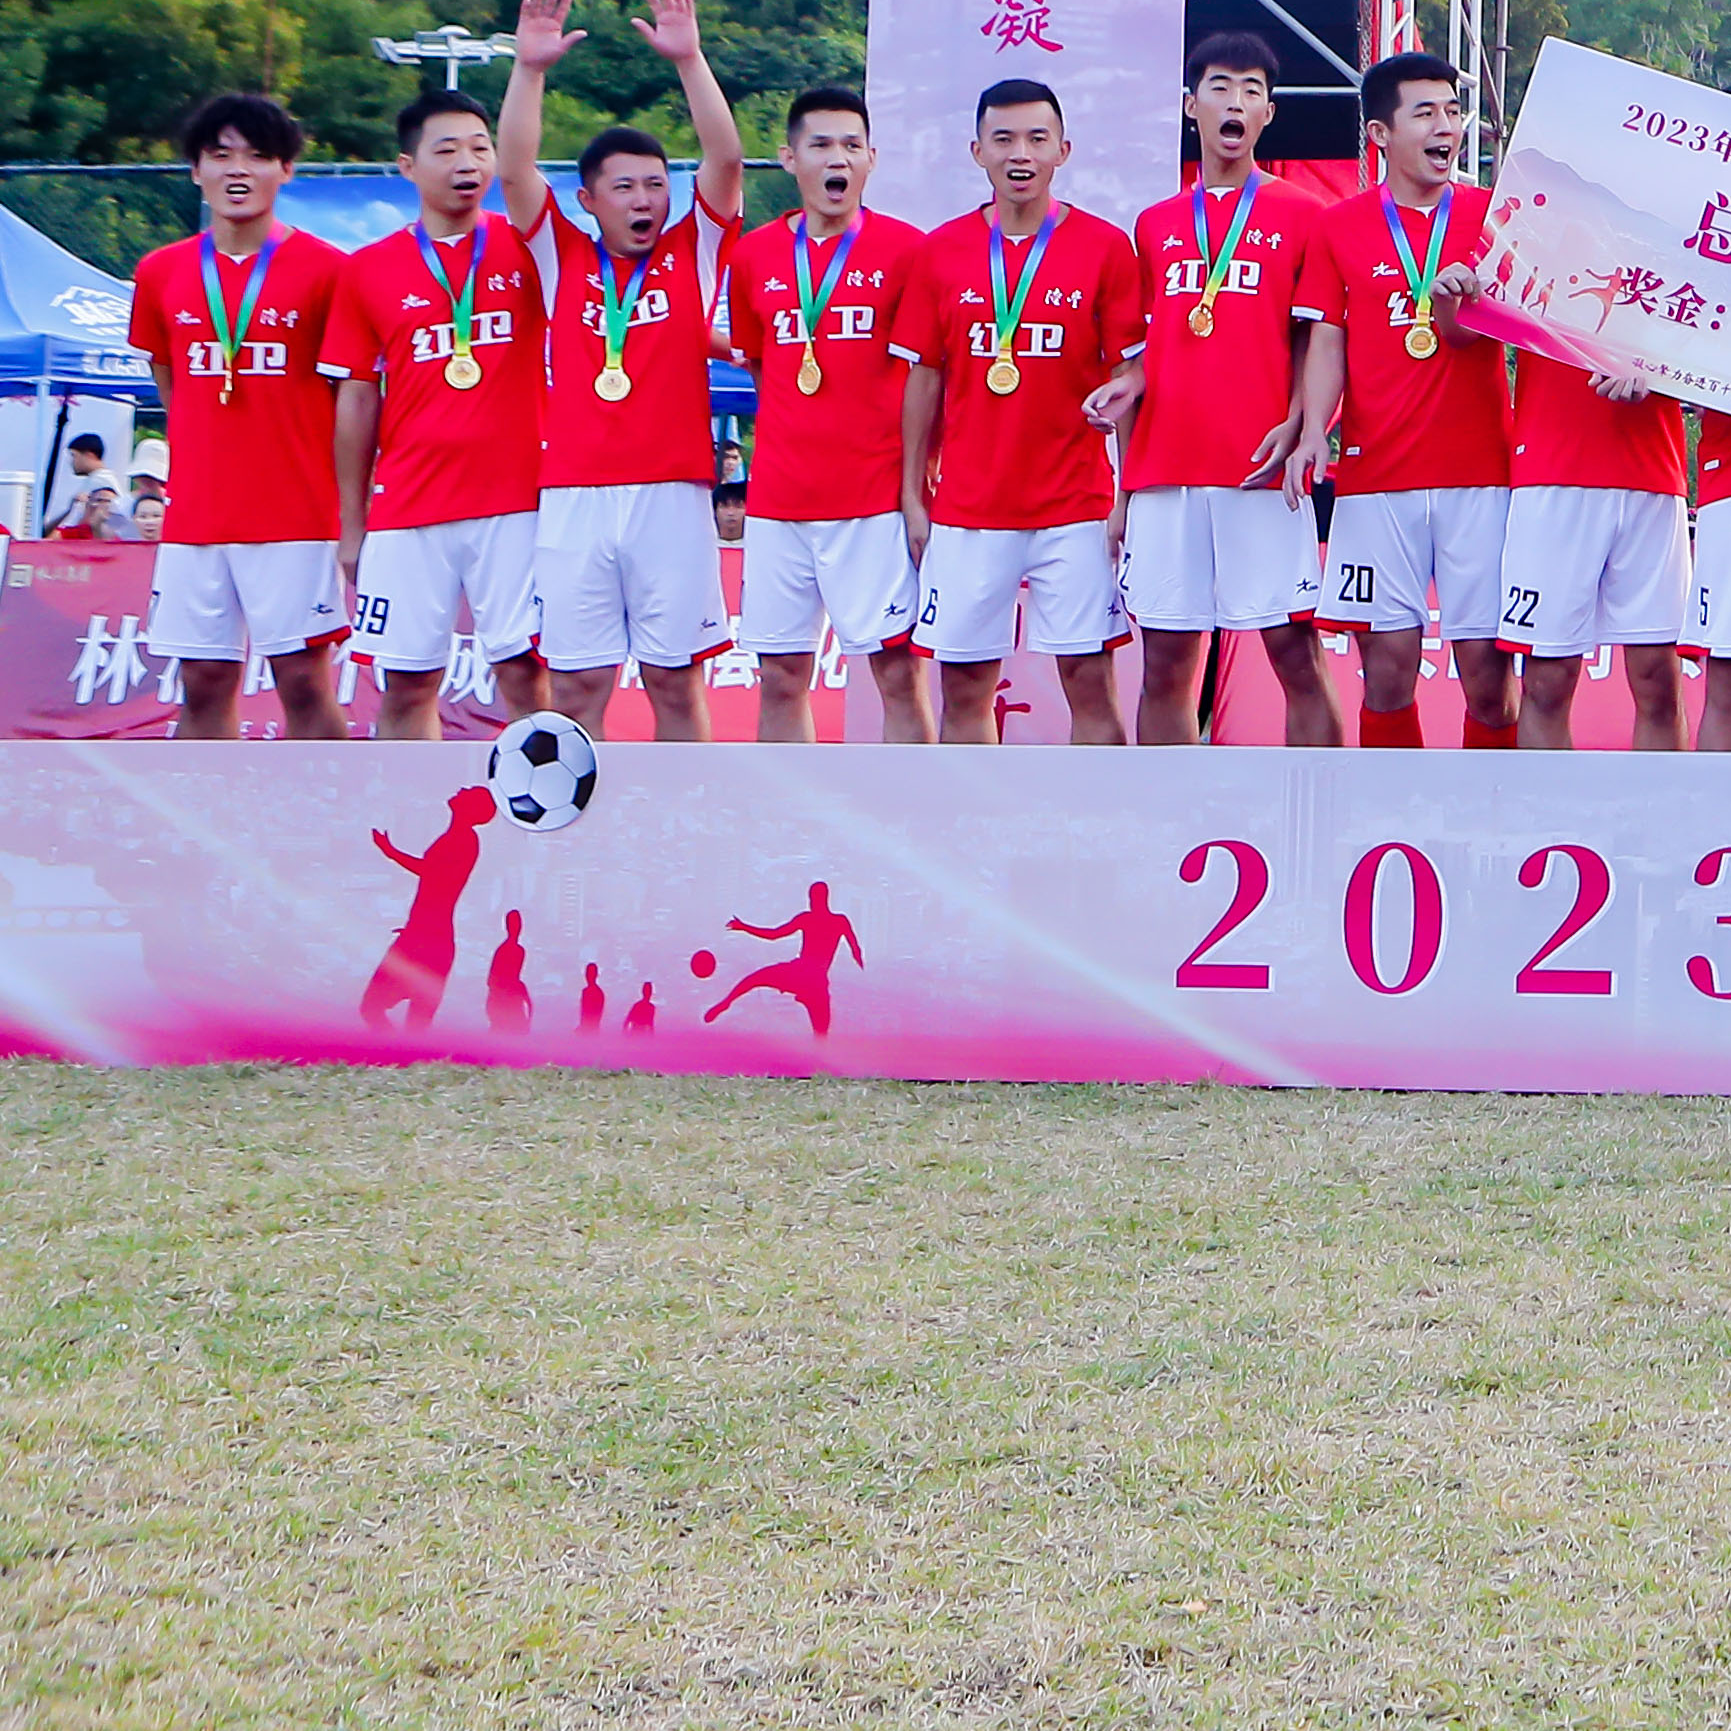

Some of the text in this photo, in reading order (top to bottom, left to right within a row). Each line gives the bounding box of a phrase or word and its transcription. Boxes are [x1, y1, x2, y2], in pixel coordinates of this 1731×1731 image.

[1165, 259, 1261, 296] 红卫
[411, 311, 513, 363] 红卫
[773, 306, 875, 345] 红卫
[968, 322, 1065, 357] 红卫
[187, 342, 287, 375] 红卫
[1339, 564, 1374, 604] 20
[1503, 586, 1540, 628] 22
